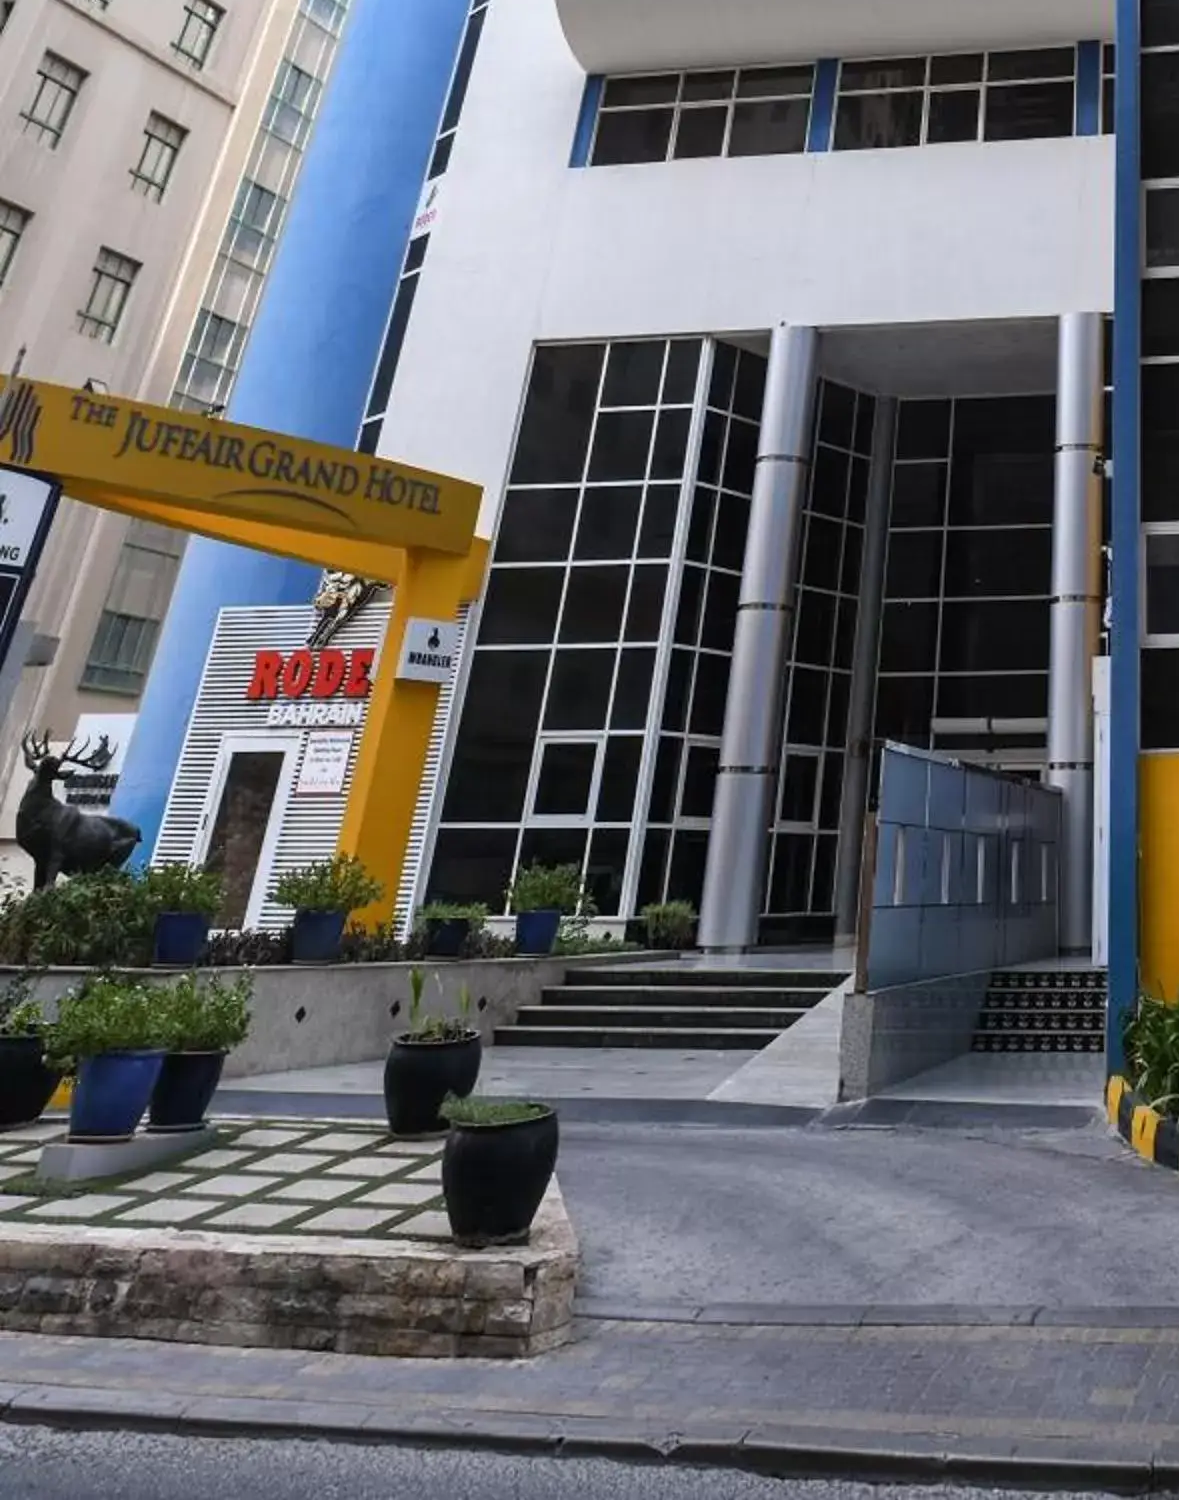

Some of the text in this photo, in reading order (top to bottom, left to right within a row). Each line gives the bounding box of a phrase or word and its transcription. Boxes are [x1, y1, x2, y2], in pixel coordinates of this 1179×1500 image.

[70, 394, 443, 516] THE JUFFAIR GRAND HOTEL
[246, 647, 376, 700] RODE
[266, 703, 365, 728] BAHRAIN
